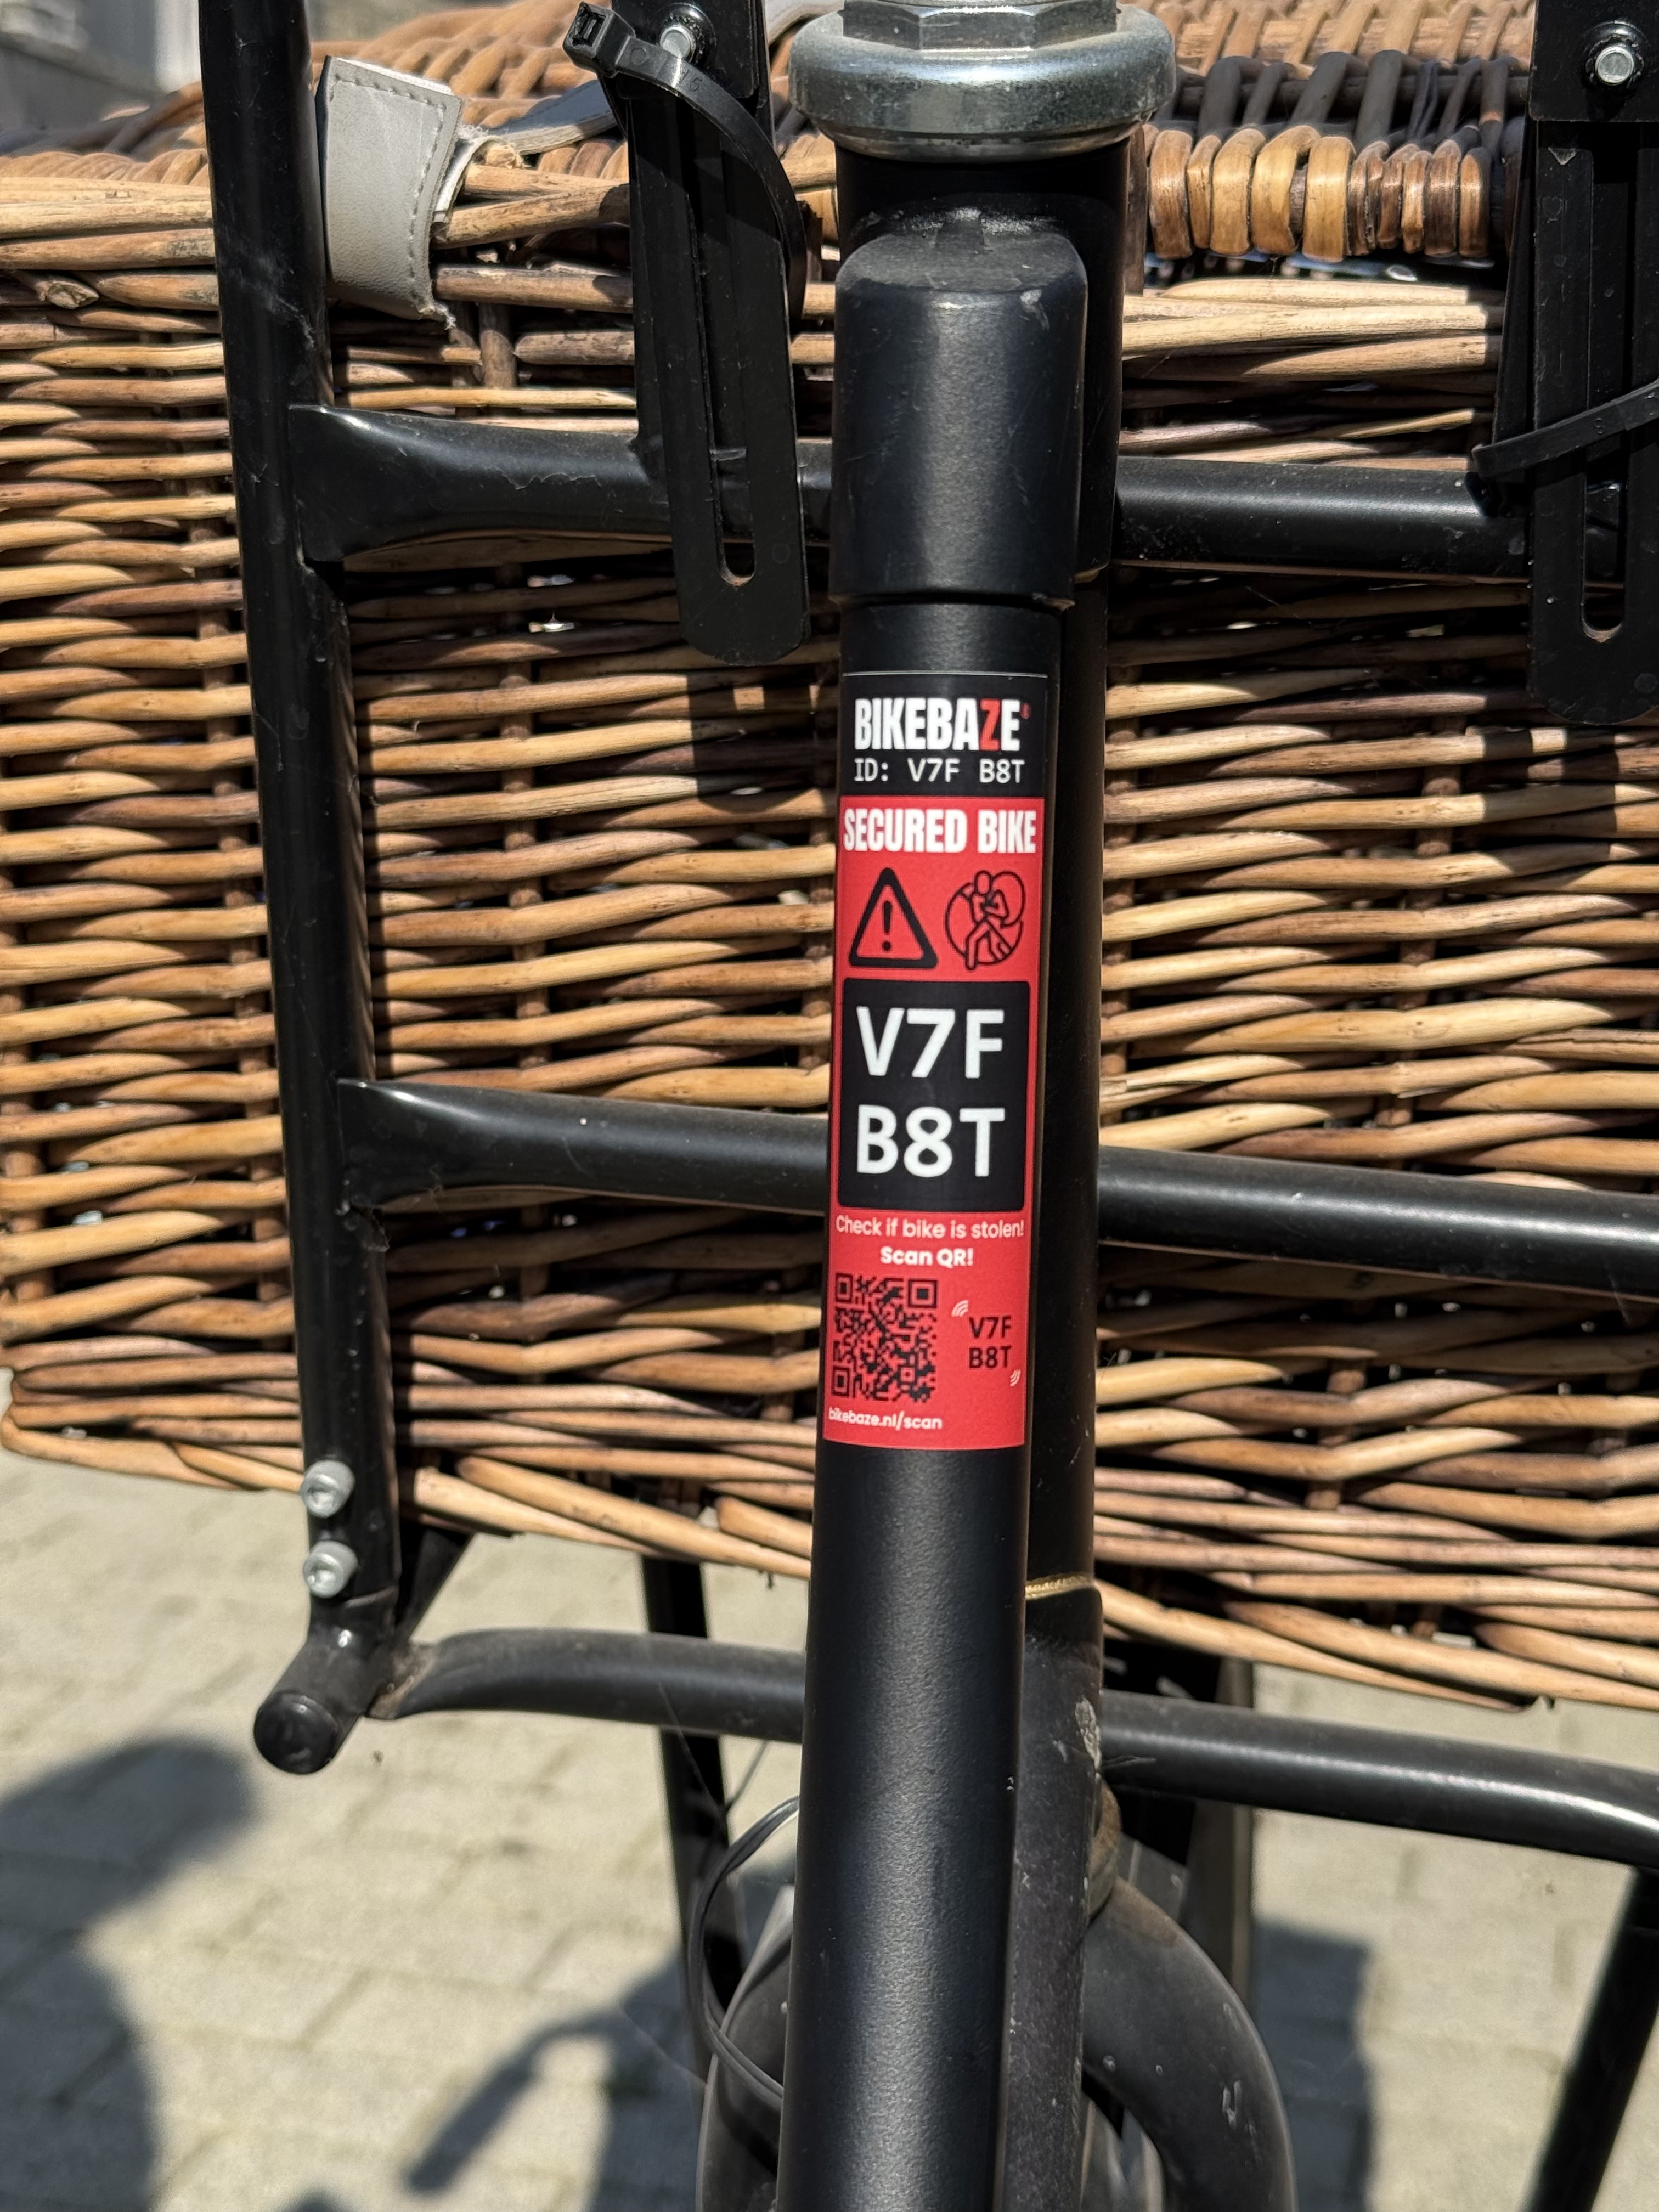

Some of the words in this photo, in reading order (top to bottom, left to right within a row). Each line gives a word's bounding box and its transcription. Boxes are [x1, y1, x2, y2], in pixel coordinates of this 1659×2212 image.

[854, 758, 889, 782] ID:
[907, 758, 960, 783] V7F
[979, 759, 1025, 783] B8T
[843, 808, 967, 853] SECURED
[977, 809, 1037, 854] BIKE
[856, 1006, 1005, 1079] V7F
[856, 1104, 1006, 1178] B8T
[836, 1215, 882, 1236] Check
[886, 1217, 898, 1237] if
[902, 1219, 946, 1238] bike
[951, 1220, 967, 1238] is
[971, 1220, 1024, 1239] stolen!
[880, 1246, 933, 1266] Scan
[936, 1248, 973, 1269] QR!
[969, 1315, 1012, 1339] V7F
[969, 1345, 1012, 1369] B8T
[828, 1407, 943, 1431] bikebaze.nl/scan
